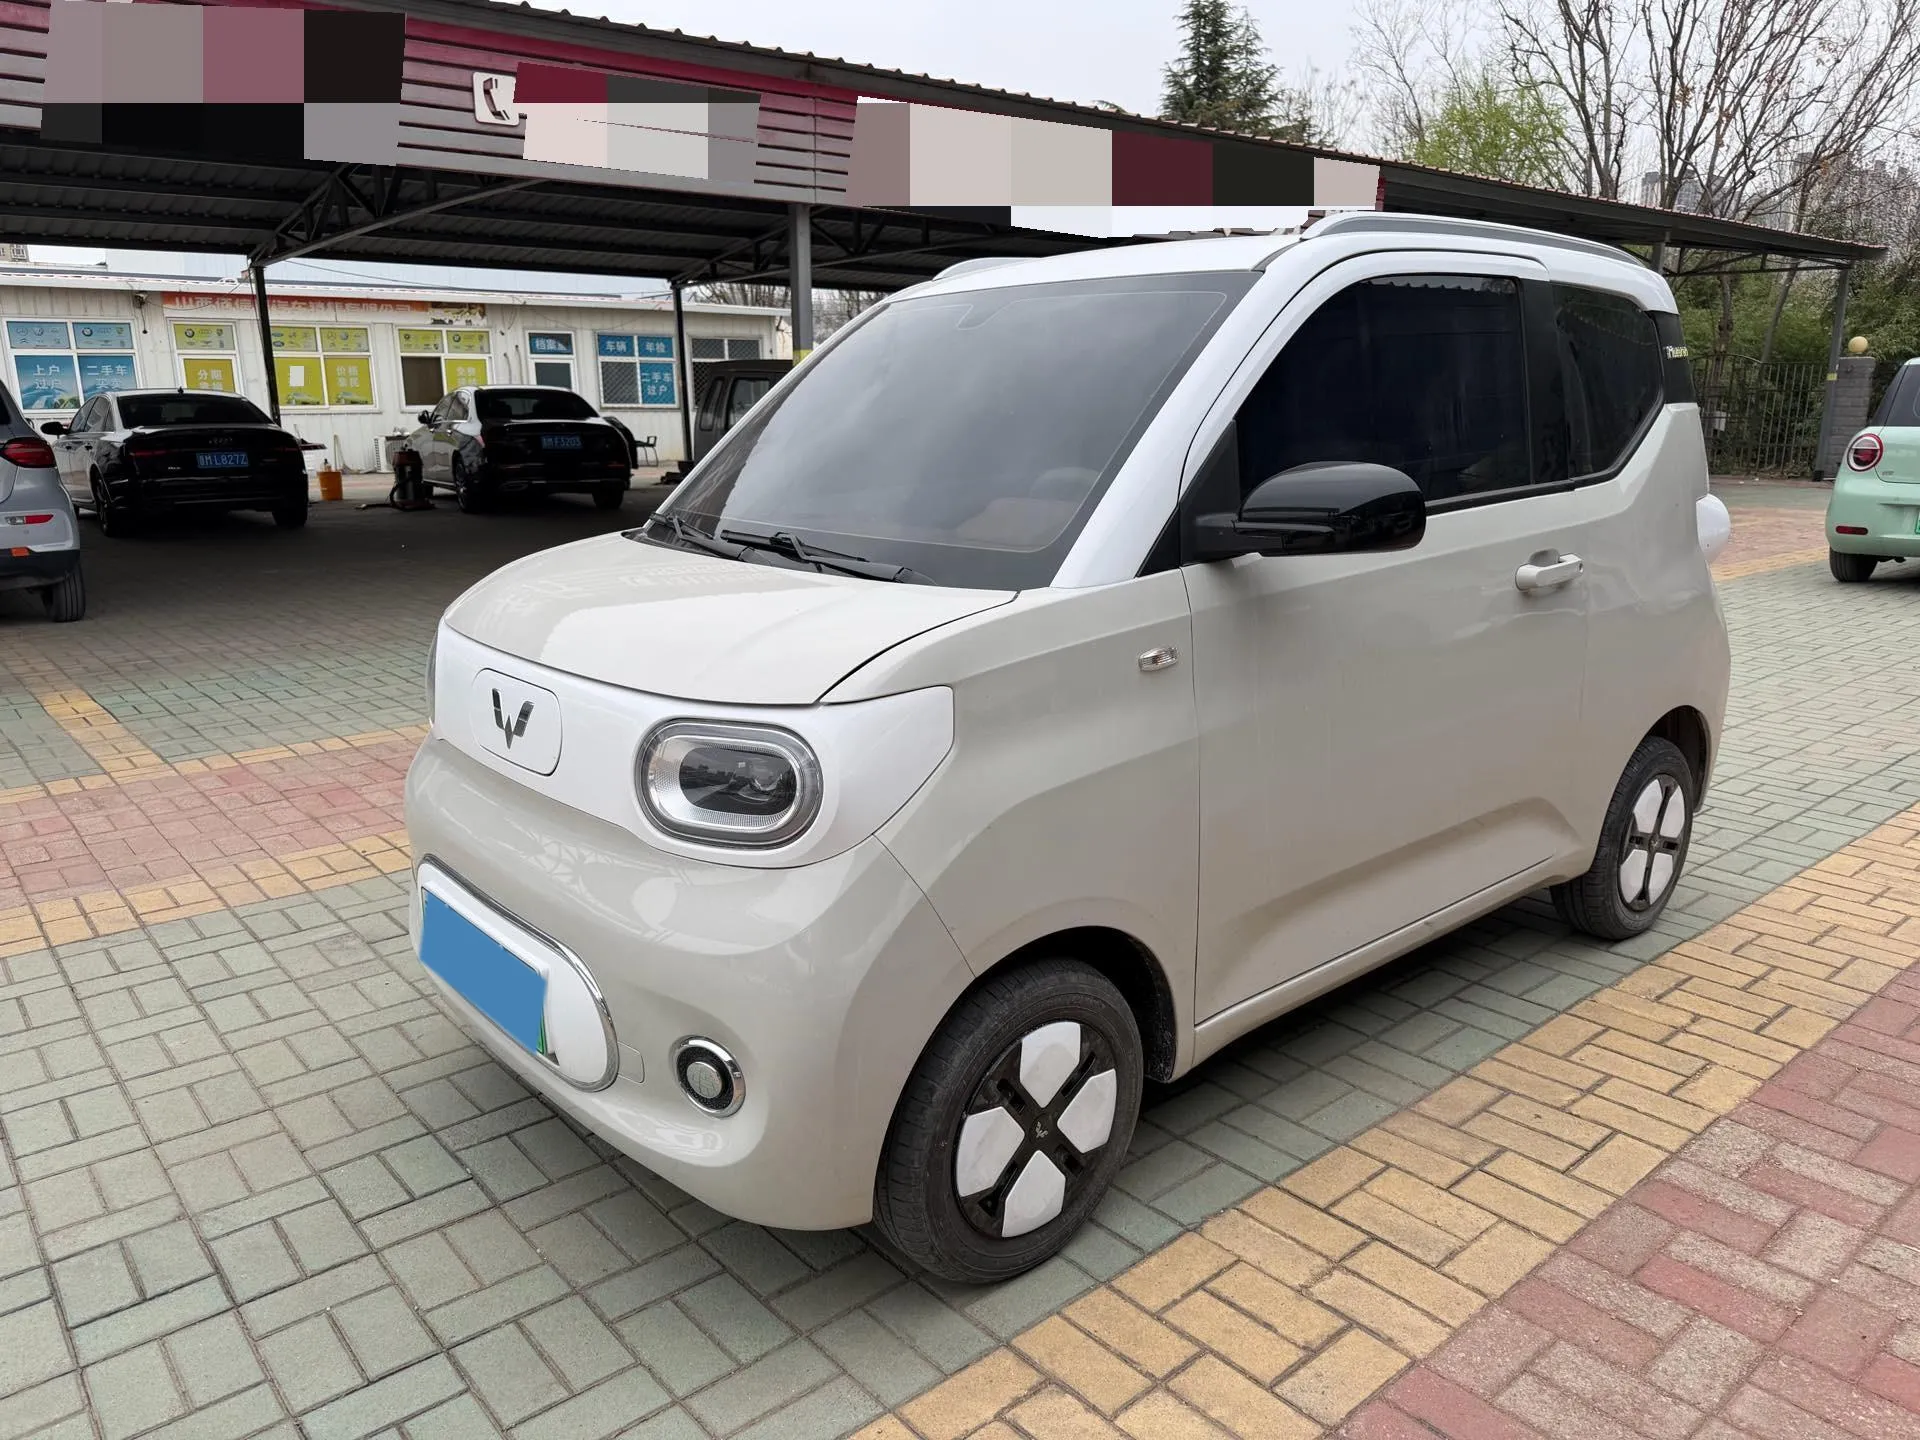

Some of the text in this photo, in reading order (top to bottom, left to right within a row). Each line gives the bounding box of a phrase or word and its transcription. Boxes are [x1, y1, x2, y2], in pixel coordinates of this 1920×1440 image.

[606, 341, 627, 352] 车辆
[645, 342, 665, 353] 年检
[33, 364, 60, 376] 上户
[87, 365, 128, 376] 二手车
[641, 372, 672, 383] 二手车
[35, 379, 60, 389] 过户
[647, 385, 667, 395] 过户
